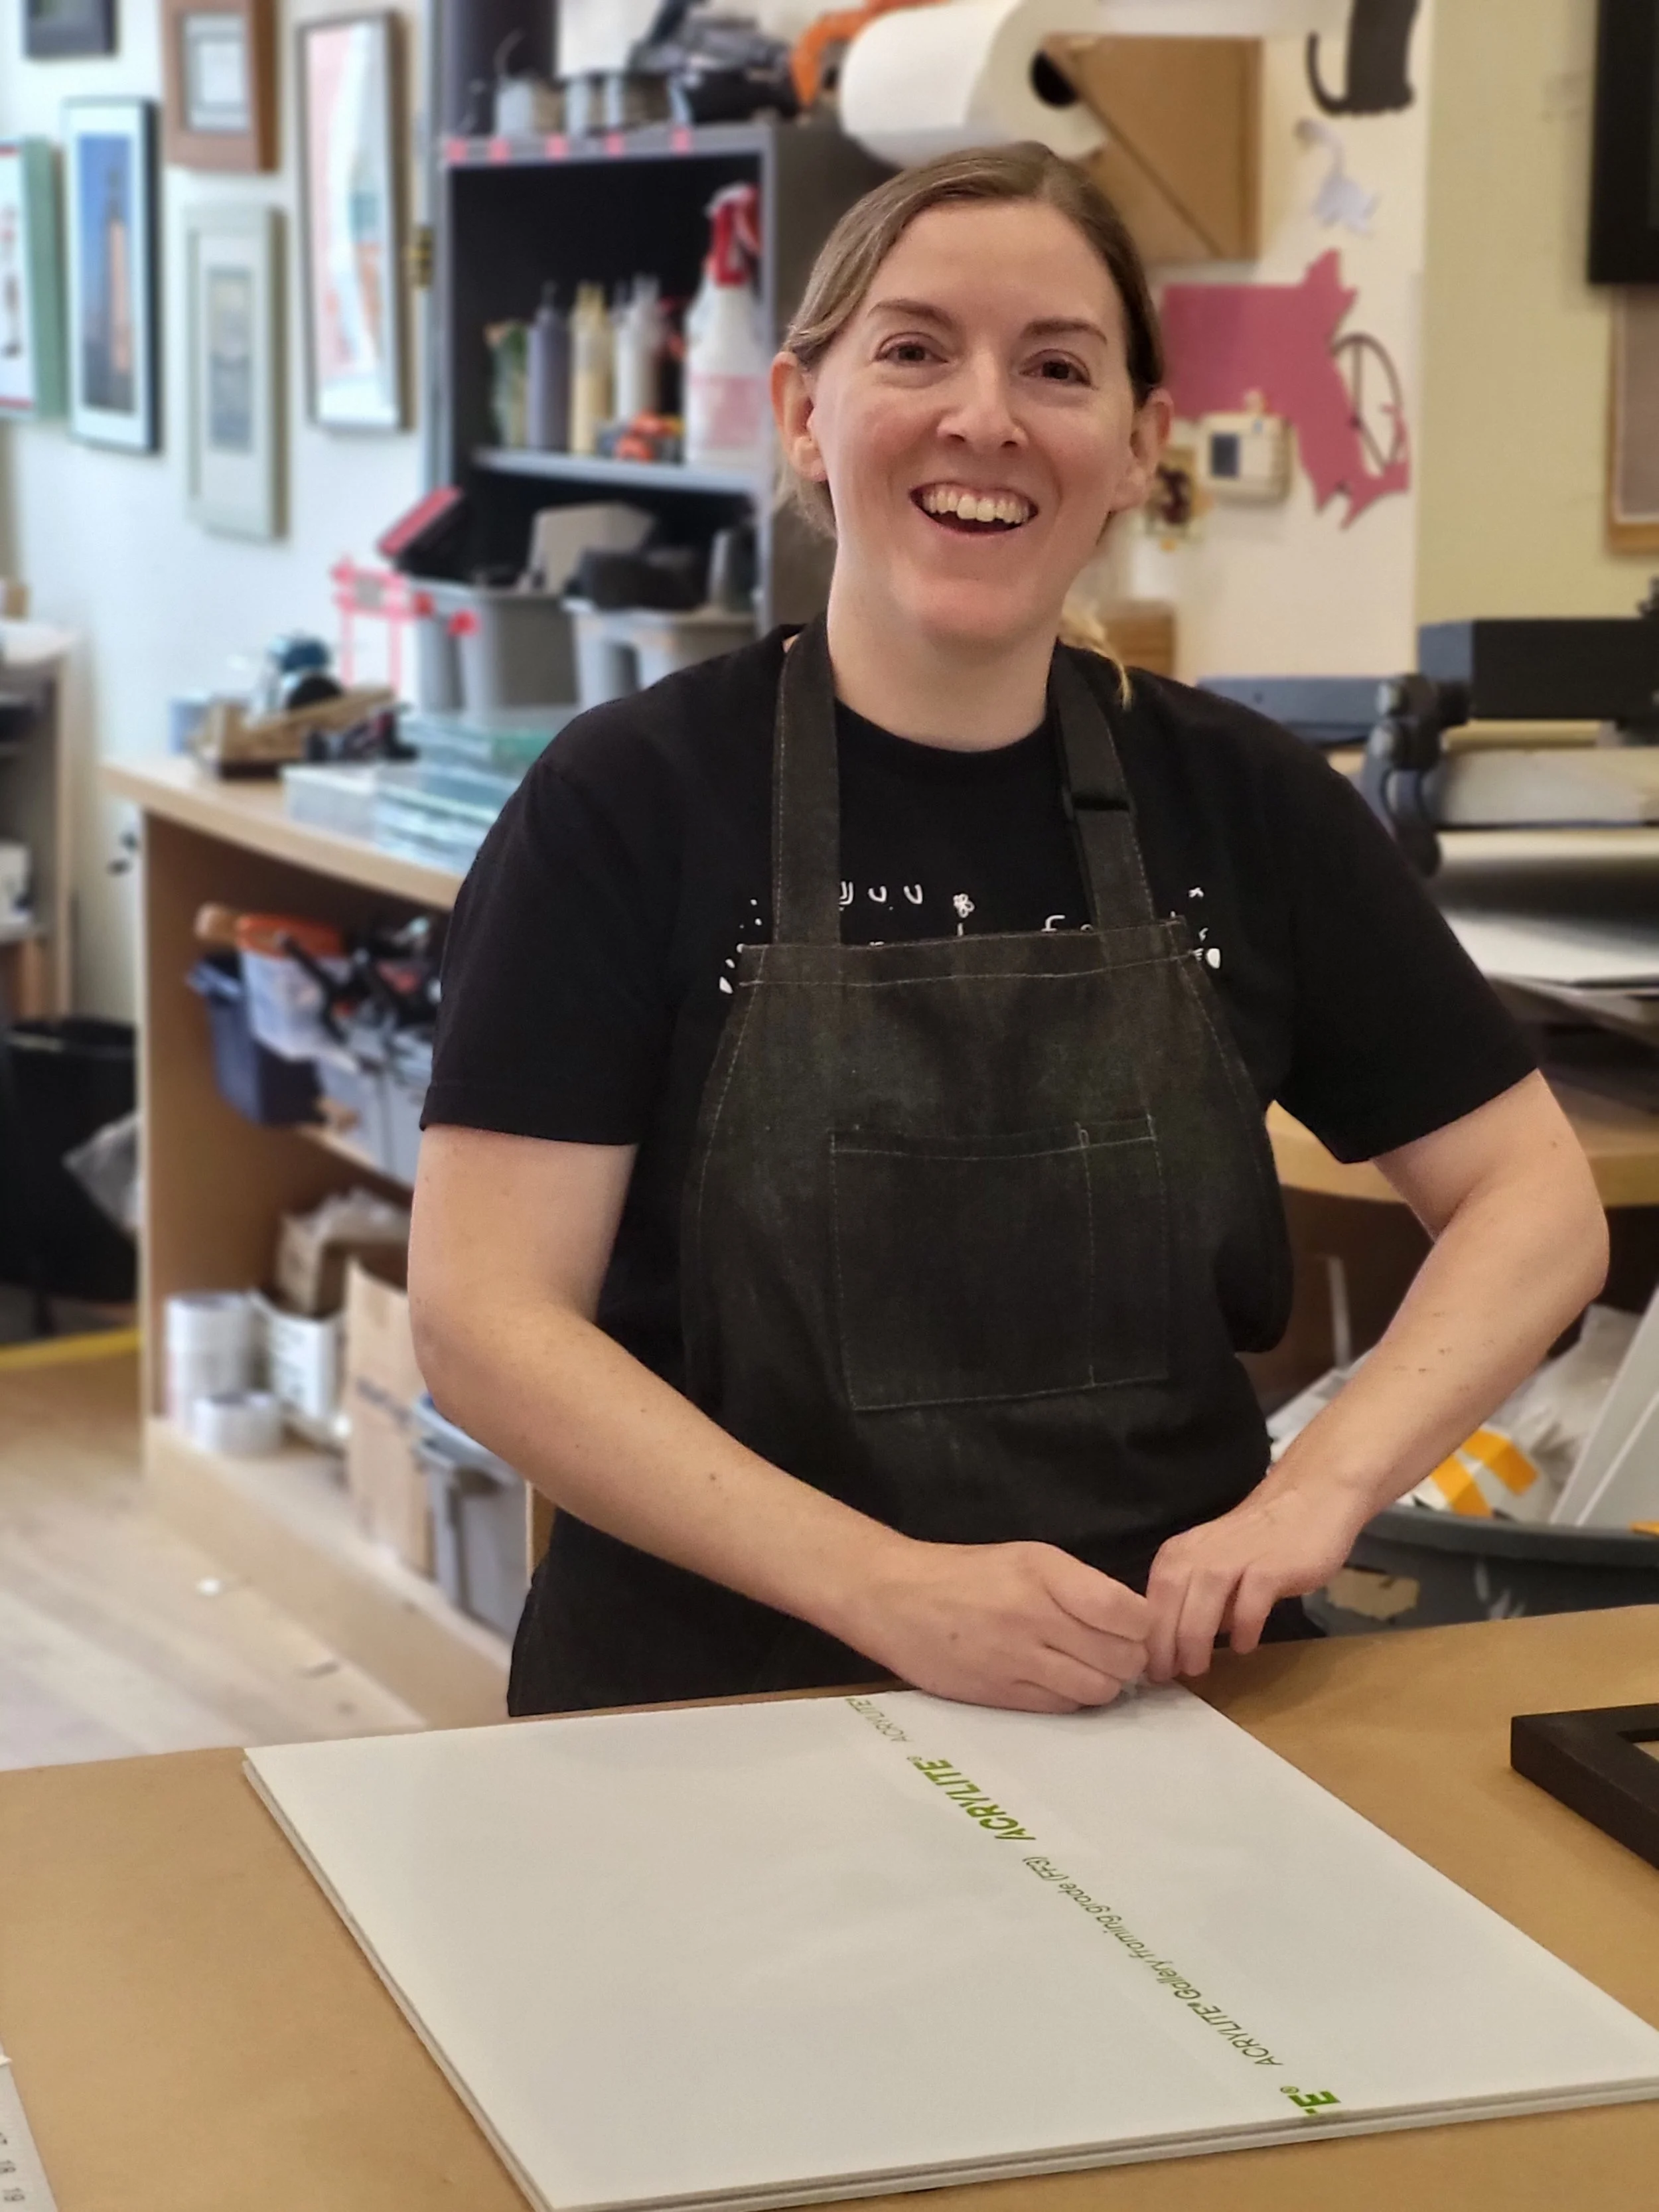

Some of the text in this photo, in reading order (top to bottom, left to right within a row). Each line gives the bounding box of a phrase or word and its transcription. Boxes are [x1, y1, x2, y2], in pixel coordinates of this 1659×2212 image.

[1022, 1856, 1069, 1881] (FF3)
[1057, 1883, 1111, 1914] grade
[1096, 1915, 1155, 1959] framing
[1145, 1960, 1202, 2000] Gallery
